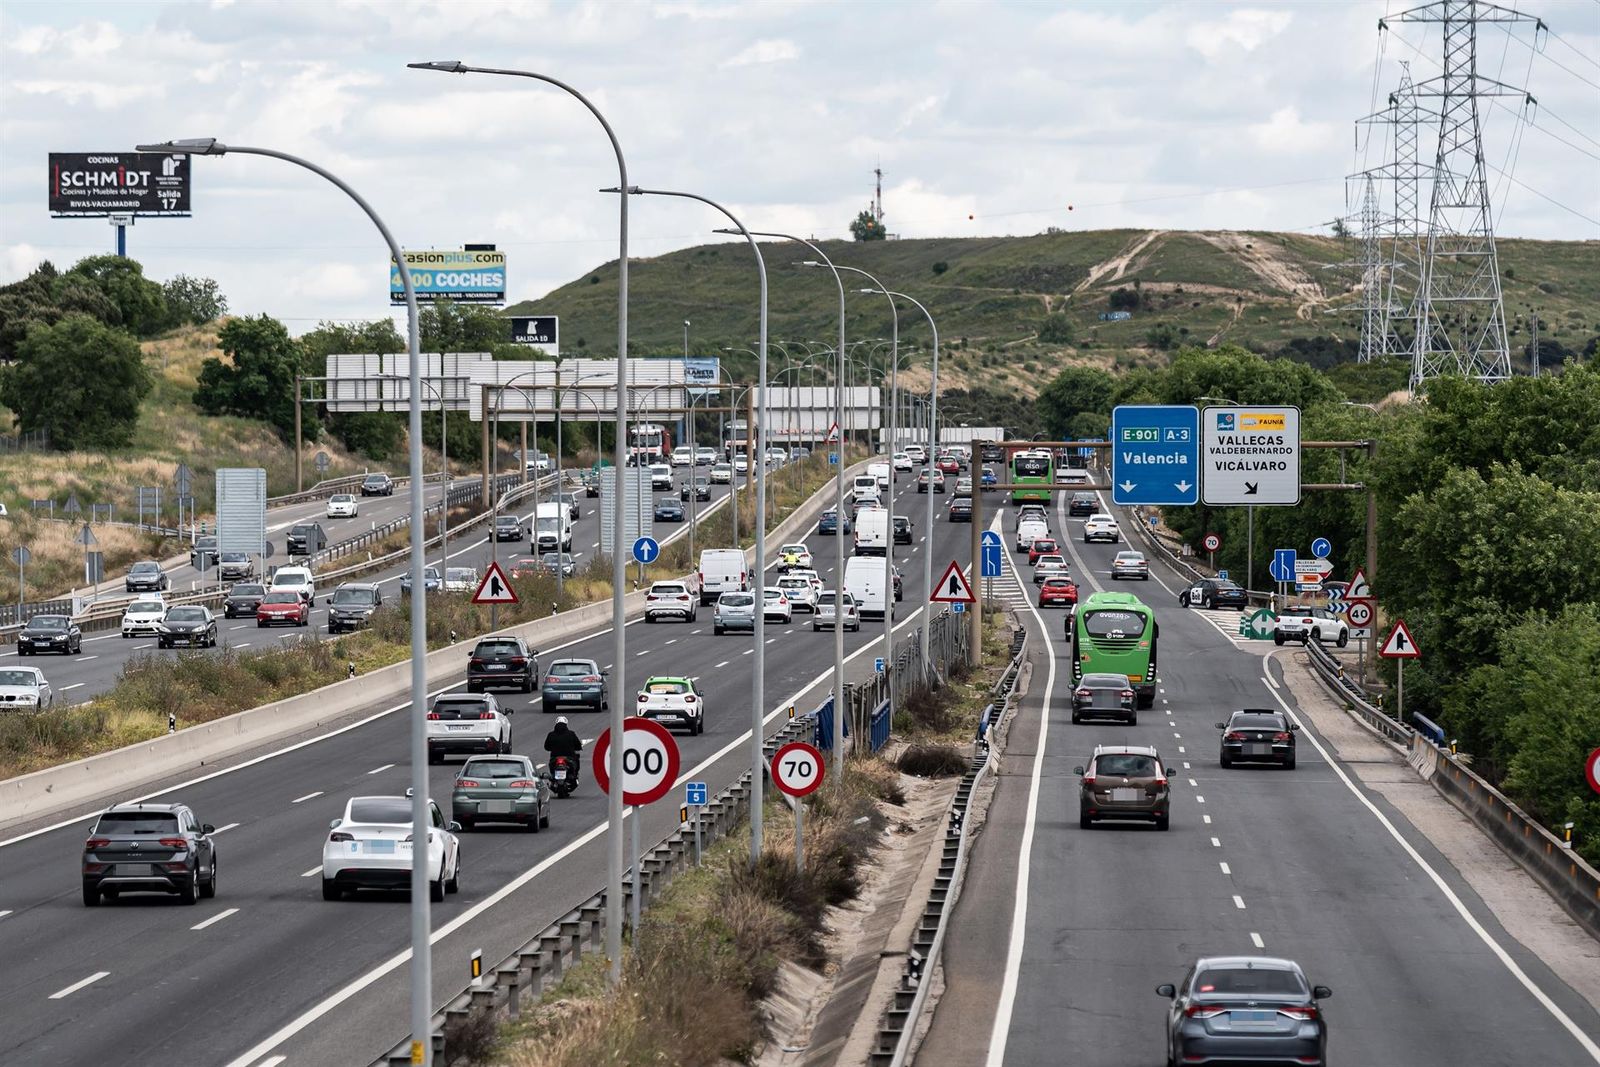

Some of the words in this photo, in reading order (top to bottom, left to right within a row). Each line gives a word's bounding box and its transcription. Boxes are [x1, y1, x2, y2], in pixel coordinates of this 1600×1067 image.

[87, 156, 119, 164] COCINAS
[129, 188, 149, 196] Hogar
[157, 190, 181, 198] Salida
[70, 200, 140, 208] RIVAS-VACIAMADRID
[162, 198, 177, 210] 17
[391, 252, 504, 264] oasionplus.com
[436, 273, 503, 287] COCHES
[1123, 430, 1158, 440] E-901
[1167, 430, 1188, 440] A-3
[1218, 436, 1284, 446] VALLECAS
[1209, 447, 1293, 455] VALDEBERNARDO
[1123, 452, 1188, 464] Valencia
[1215, 458, 1287, 471] VICÁLVARO
[1352, 609, 1368, 619] 40
[784, 761, 812, 778] 70
[693, 792, 700, 802] 5
